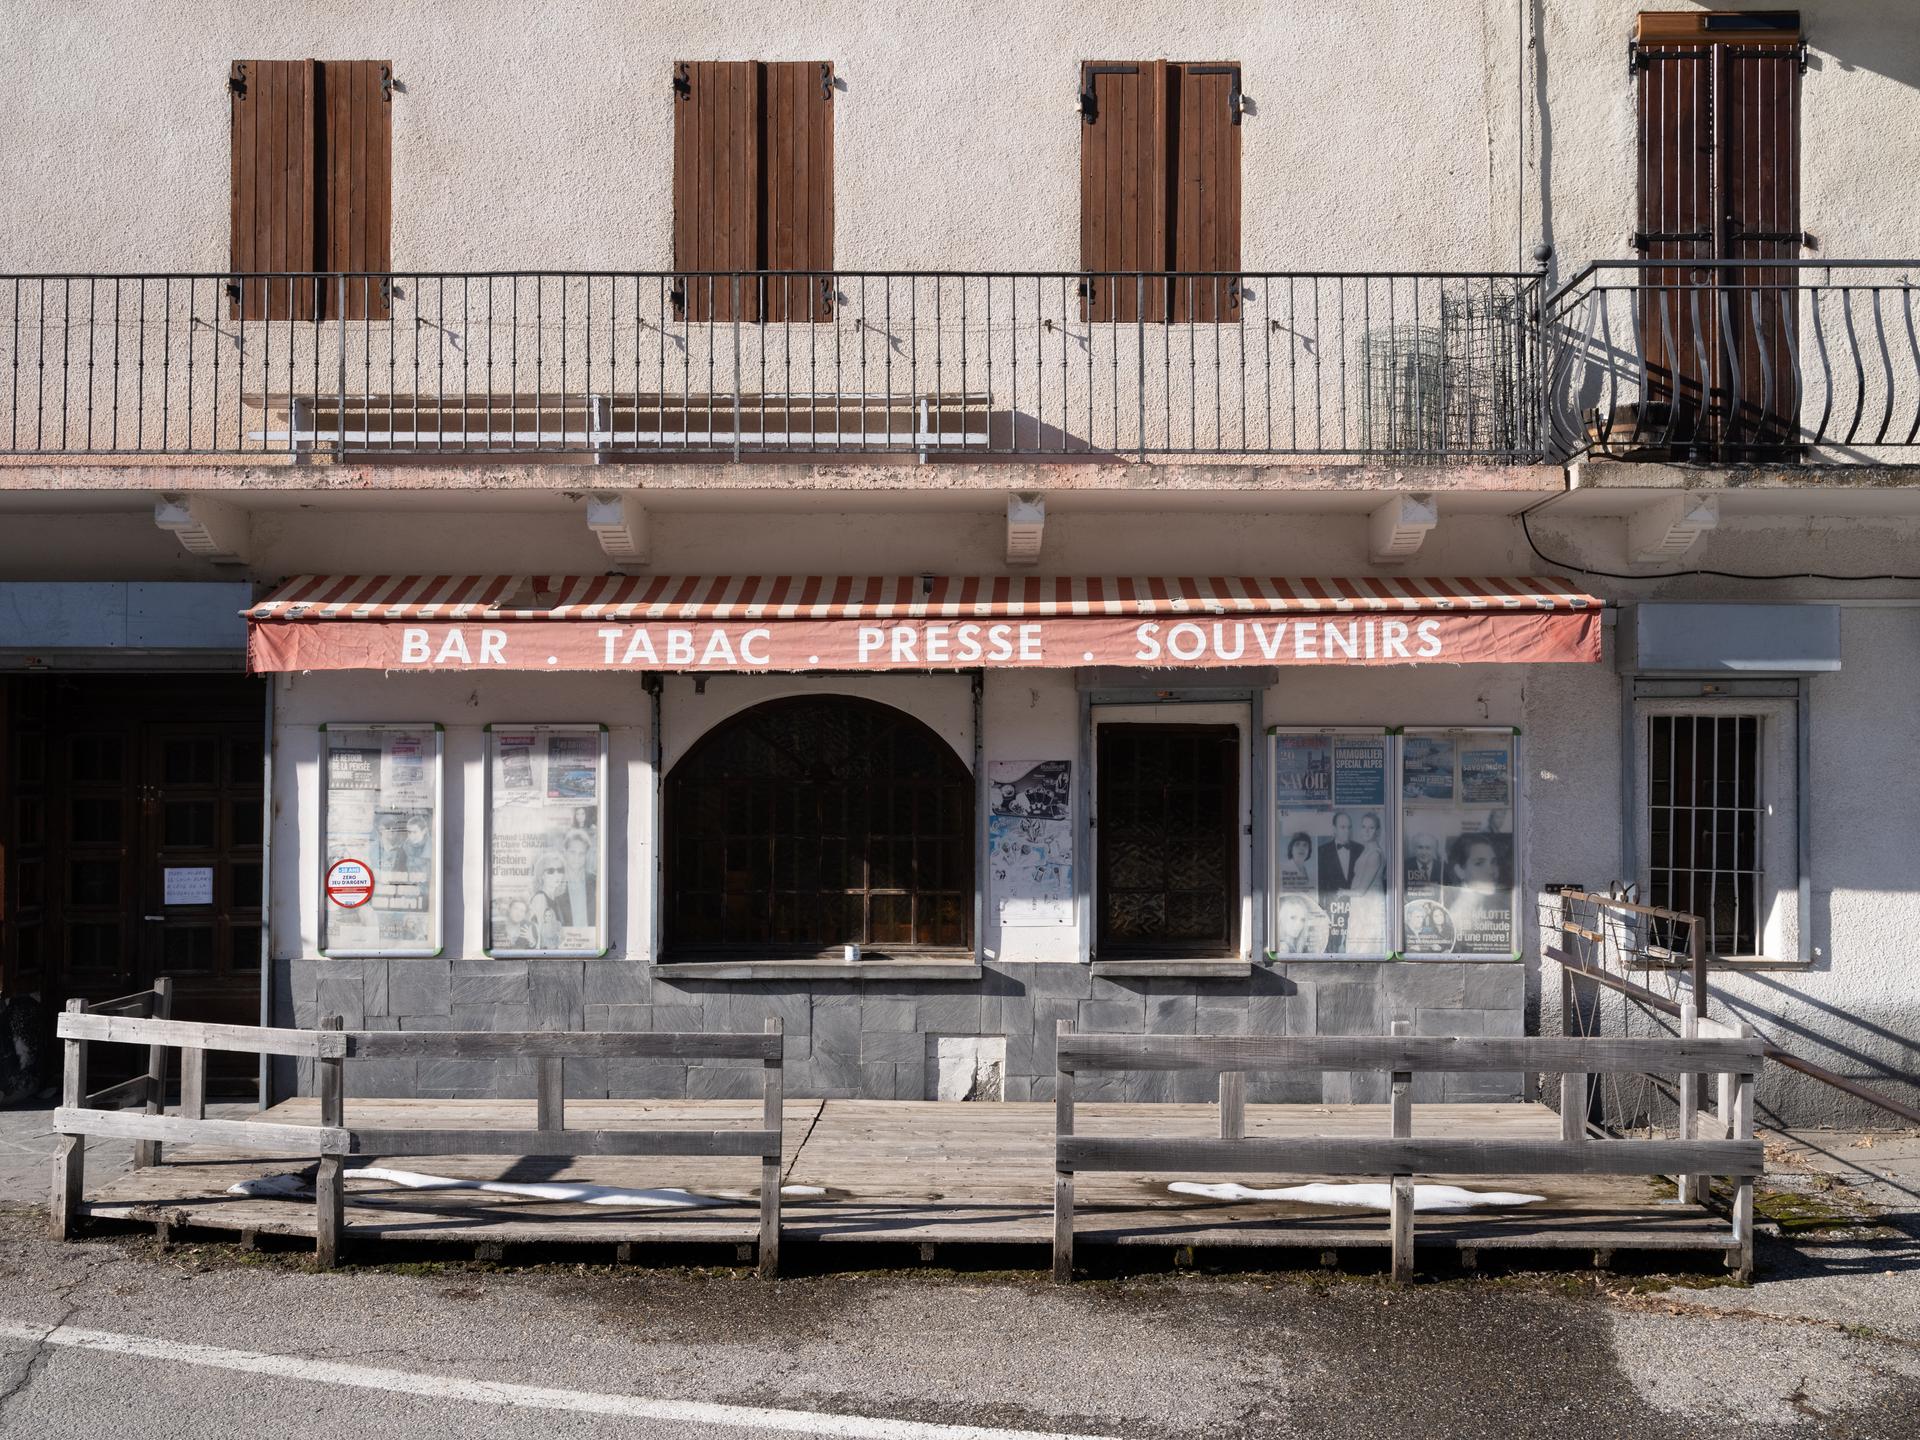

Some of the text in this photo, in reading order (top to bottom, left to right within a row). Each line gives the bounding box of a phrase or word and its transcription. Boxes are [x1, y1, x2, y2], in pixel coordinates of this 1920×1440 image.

[401, 627, 508, 665] BAR
[598, 627, 772, 666] TABAC
[858, 625, 1043, 665] PRESSE
[1135, 619, 1443, 662] SOUVENIRS
[1335, 749, 1383, 760] IMMOBILIER
[1363, 759, 1383, 769] ALPES
[1280, 772, 1329, 790] SAVOIE
[493, 854, 527, 865] histoire
[1331, 913, 1345, 927] Le
[1473, 920, 1510, 931] solitude
[1456, 930, 1481, 942] d'une
